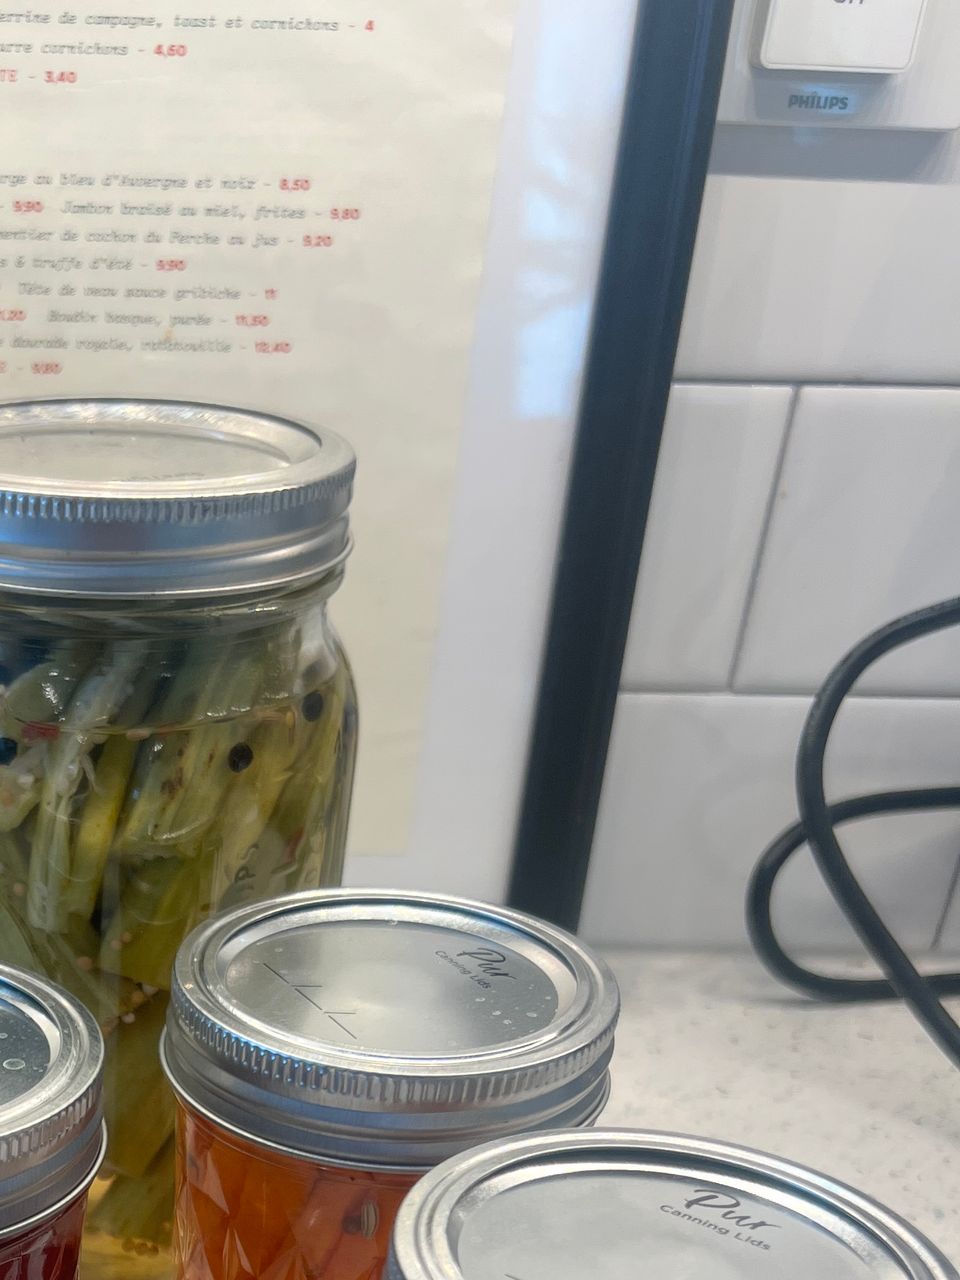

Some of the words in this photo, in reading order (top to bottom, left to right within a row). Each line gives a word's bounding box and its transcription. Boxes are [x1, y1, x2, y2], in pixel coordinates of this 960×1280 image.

[57, 12, 76, 25] de
[85, 14, 162, 29] campagne,
[173, 14, 217, 29] toast
[224, 17, 242, 29] et
[250, 17, 339, 31] cornichons
[364, 20, 376, 32] 4
[40, 42, 129, 56] cornichons
[44, 70, 77, 84] 3,40
[788, 93, 849, 110] PHILIPS
[34, 175, 52, 186] au
[59, 172, 95, 186] bleu
[101, 174, 189, 191] d'Auvergne
[194, 178, 213, 189] et
[60, 200, 113, 215] Jambon
[120, 201, 172, 216] braisé
[178, 206, 197, 217] au
[204, 205, 245, 219] miel,
[254, 205, 307, 221] frites
[60, 228, 79, 242] de
[86, 230, 136, 243] cochon
[169, 231, 220, 245] Perche
[227, 235, 246, 246] au
[252, 233, 279, 248] jus
[58, 284, 76, 296] de
[456, 947, 517, 981] Pur
[683, 1188, 782, 1231] Pur
[659, 1204, 730, 1235] Canning
[733, 1231, 771, 1251] Lids
